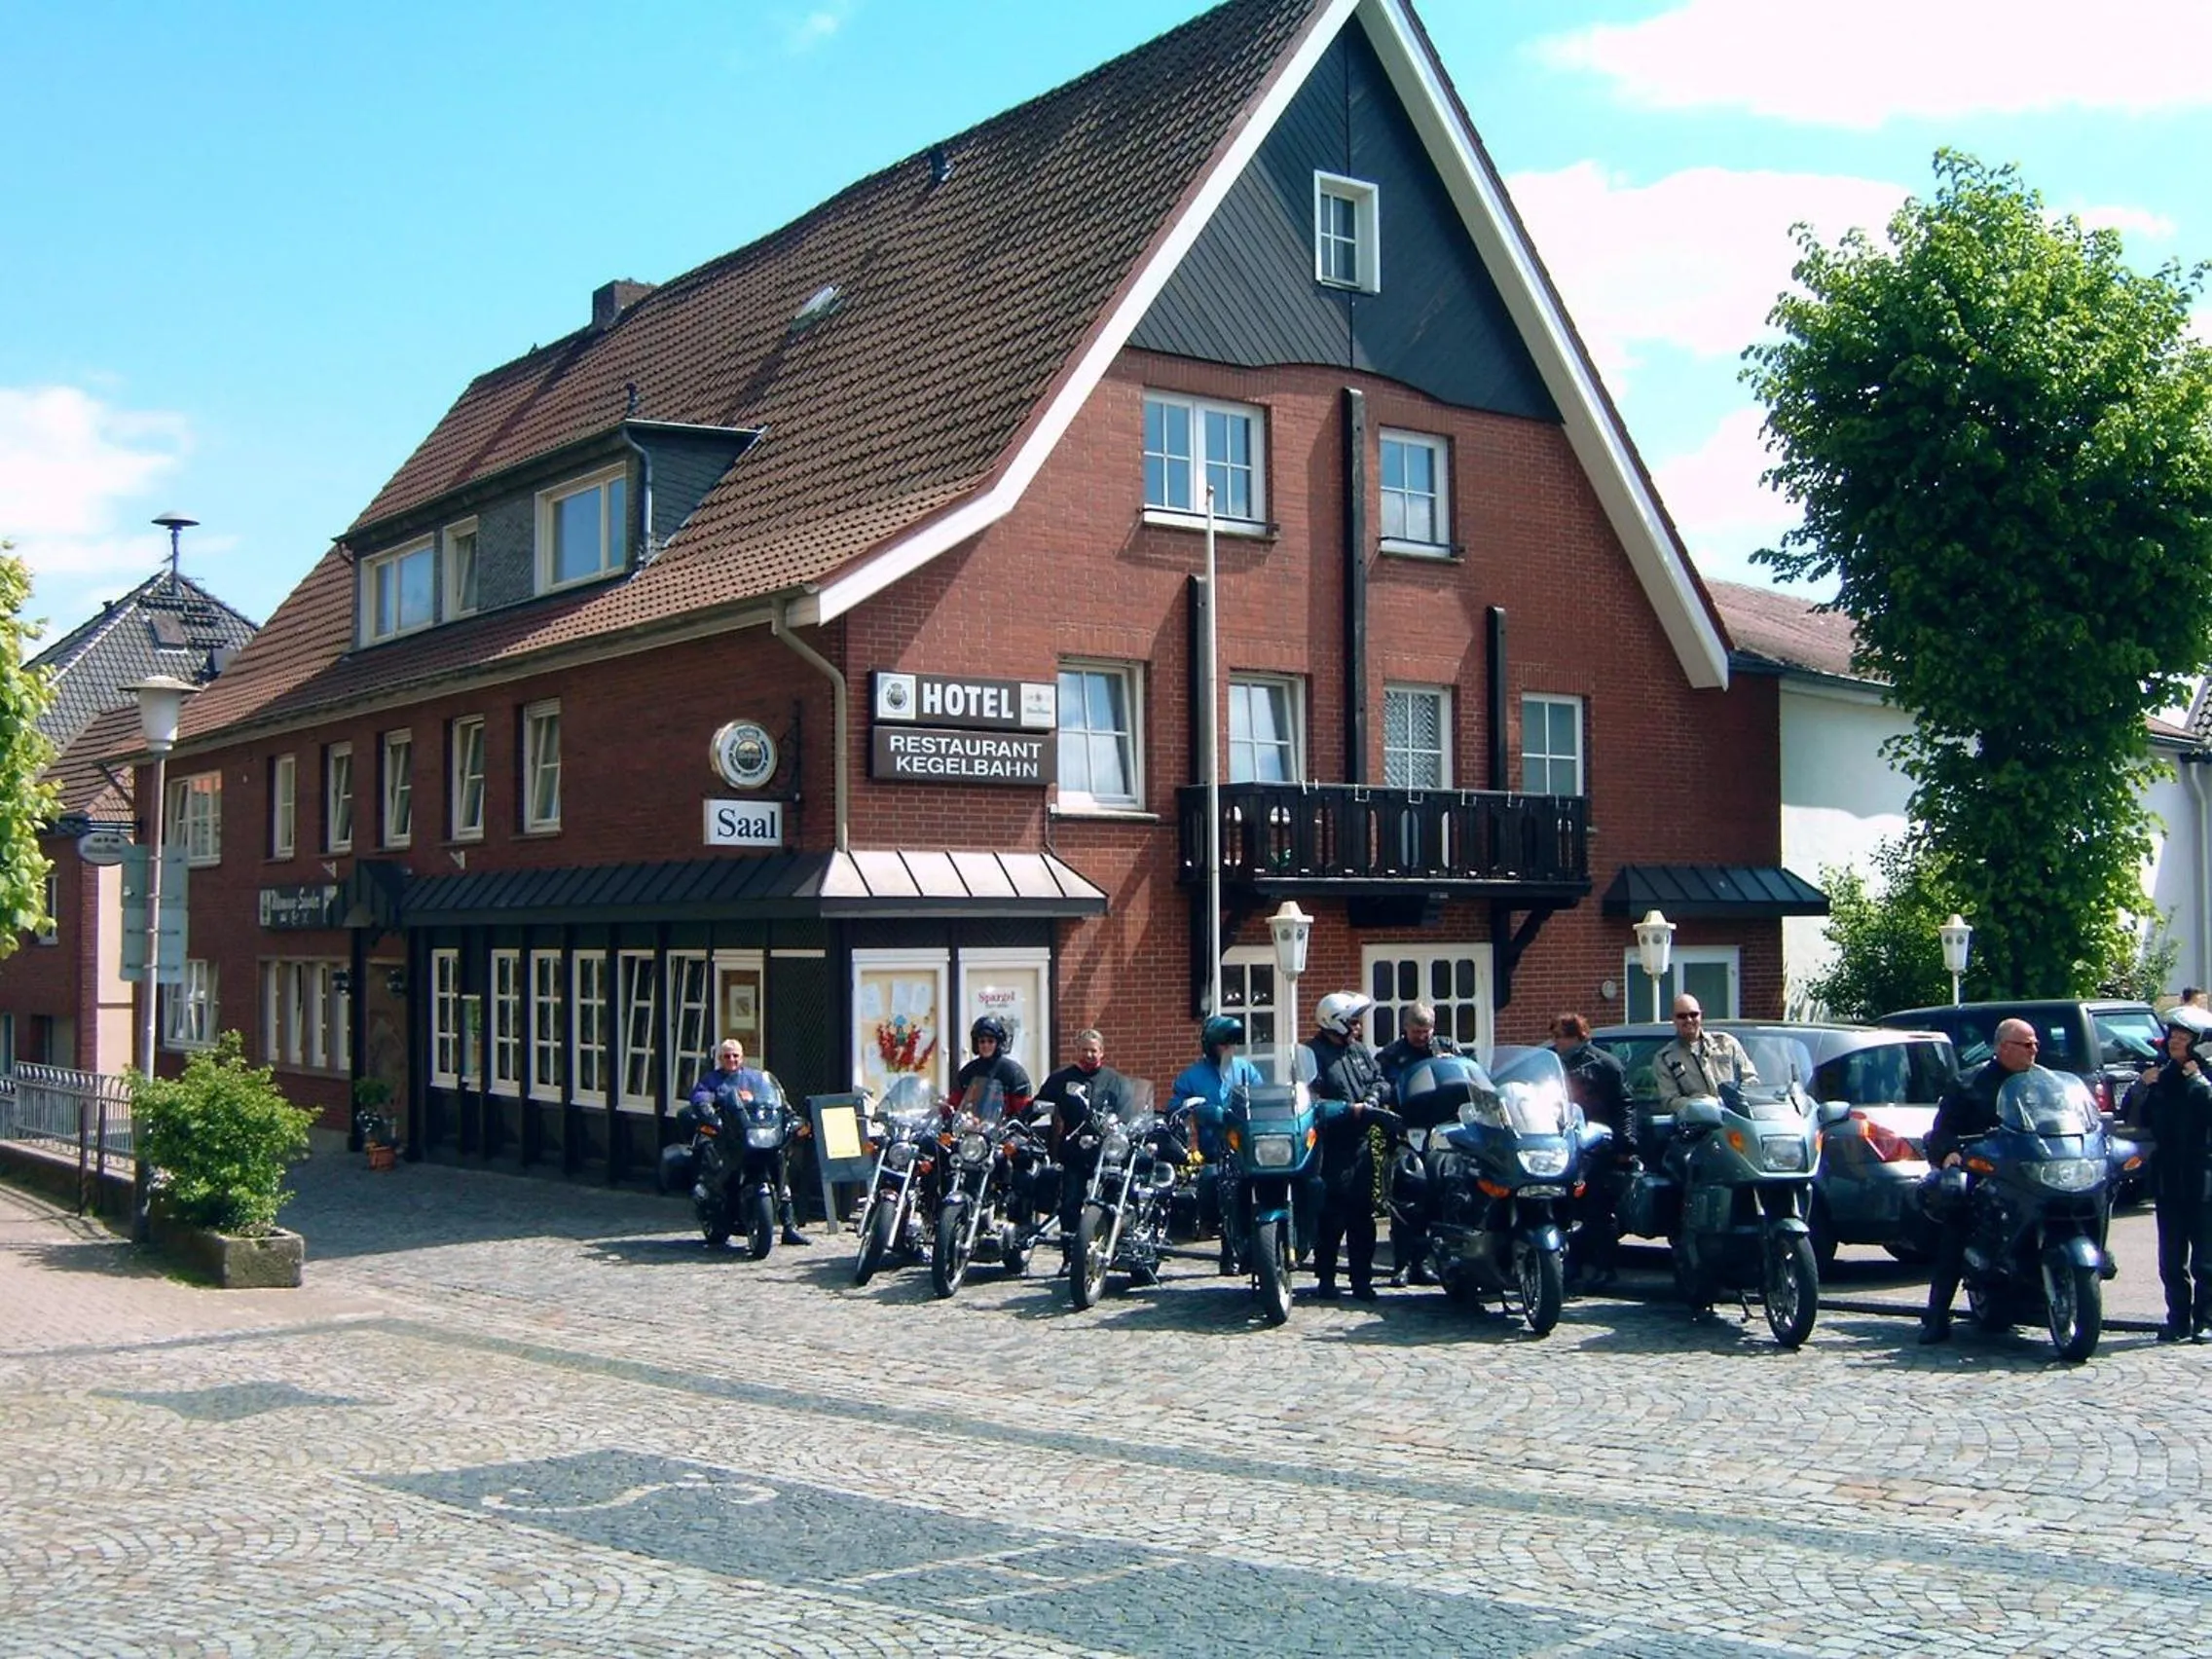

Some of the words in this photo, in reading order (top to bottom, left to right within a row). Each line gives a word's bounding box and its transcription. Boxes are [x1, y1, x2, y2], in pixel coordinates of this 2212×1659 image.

[923, 682, 1014, 719] HOTEL
[890, 735, 1043, 758] RESTAURANT
[896, 756, 1039, 777] KEGELBAHN
[718, 807, 777, 838] Saal
